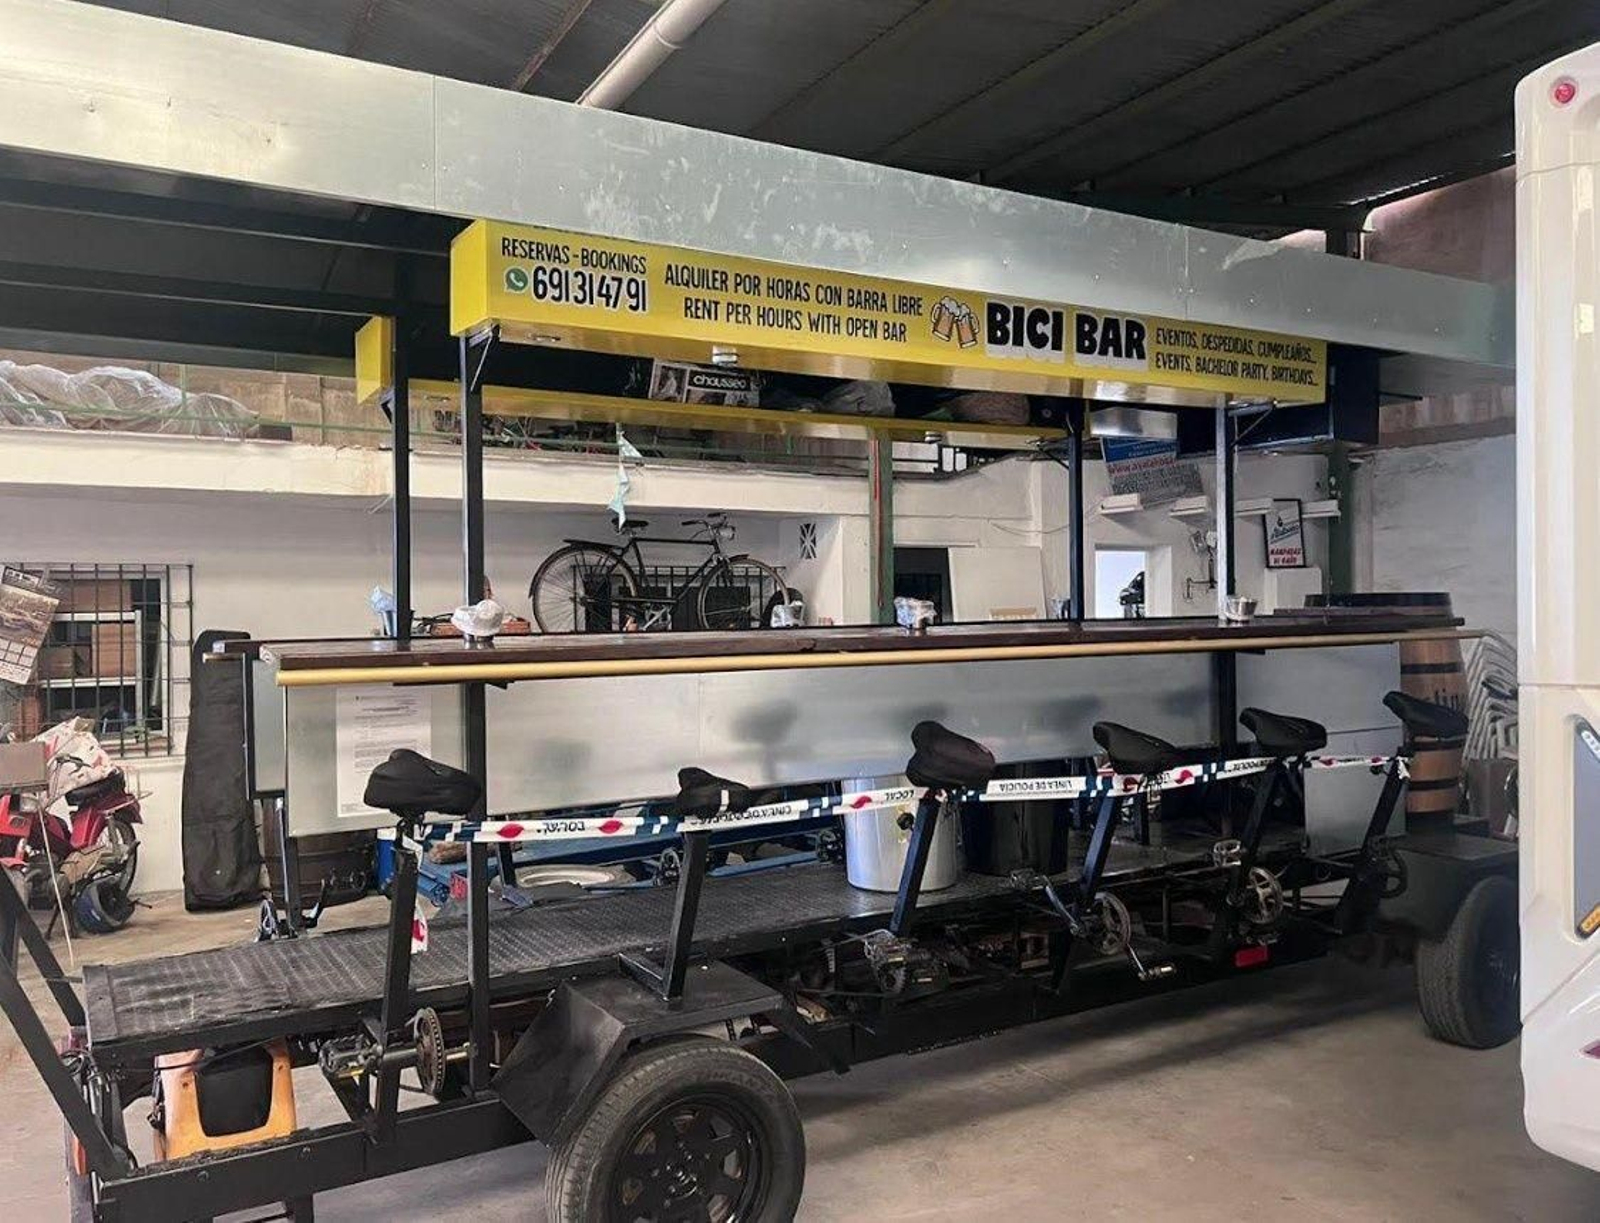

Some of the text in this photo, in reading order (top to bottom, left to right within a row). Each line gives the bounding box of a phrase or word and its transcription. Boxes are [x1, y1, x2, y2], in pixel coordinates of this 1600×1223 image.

[502, 237, 570, 264] RESERVAS
[581, 247, 647, 275] BOOKINGS
[532, 265, 647, 312] 691314791
[664, 264, 923, 317] ALQUILER POR HORAS CON BARRA LIBRE
[683, 296, 907, 343] RENT PER HOURS WITH OPEN BAR
[986, 301, 1146, 360] BICI BAR
[1155, 327, 1199, 350] EVENTOS,
[1155, 351, 1192, 375] EVENTS,
[1195, 356, 1239, 378] BACHELOR
